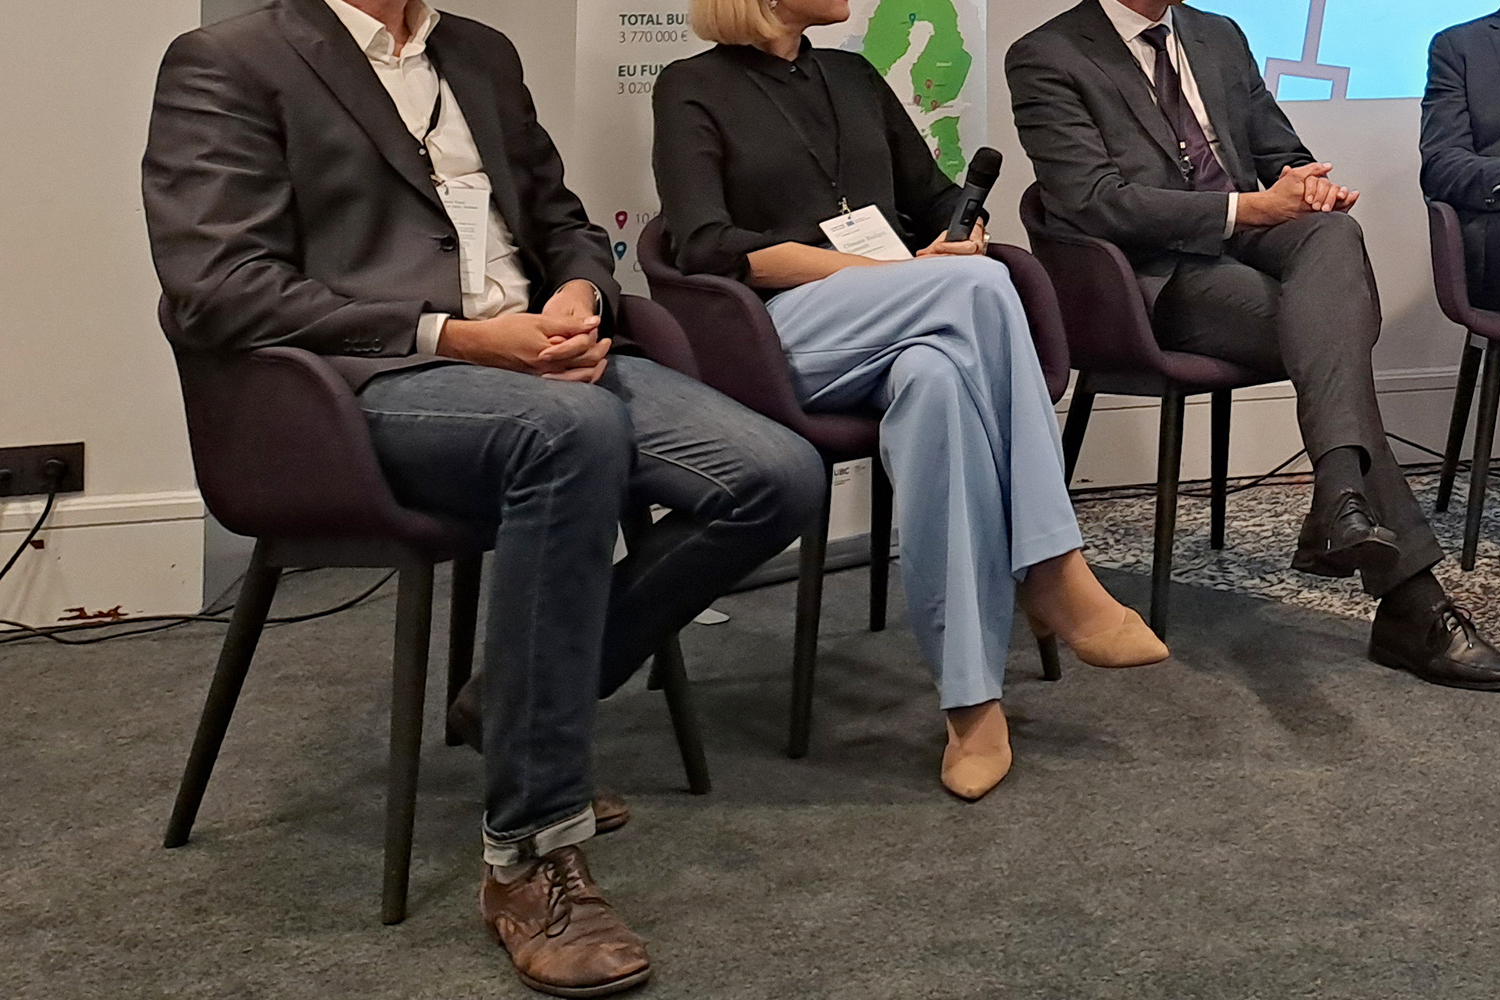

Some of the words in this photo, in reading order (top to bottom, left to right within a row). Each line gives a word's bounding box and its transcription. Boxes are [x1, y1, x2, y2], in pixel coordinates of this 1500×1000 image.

[619, 13, 663, 26] TOTAL
[619, 30, 626, 44] 3
[630, 30, 653, 43] 770
[655, 30, 678, 43] 000
[681, 29, 689, 42] €
[618, 64, 637, 77] EU
[617, 81, 625, 95] 3
[628, 81, 652, 94] 020
